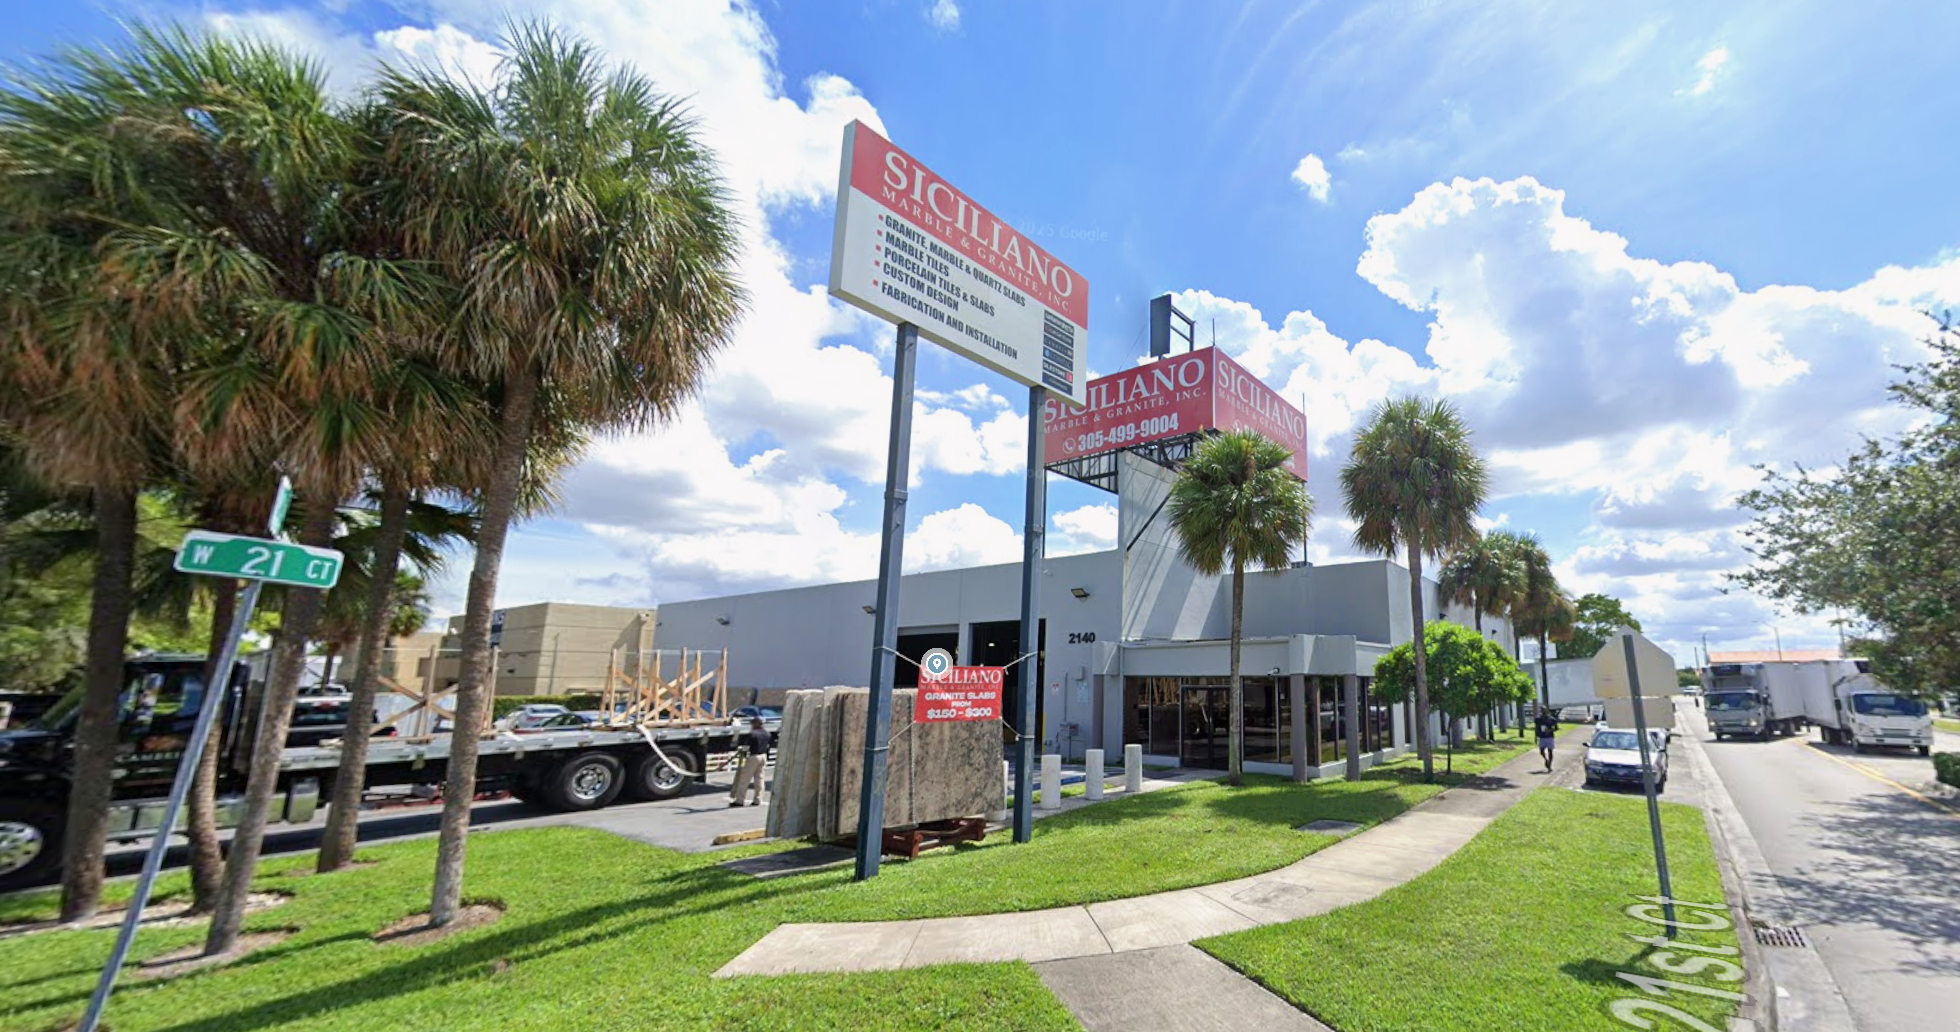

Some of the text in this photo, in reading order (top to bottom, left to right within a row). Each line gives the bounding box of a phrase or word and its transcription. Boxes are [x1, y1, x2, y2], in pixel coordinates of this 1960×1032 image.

[884, 151, 1072, 297] SICILIANO
[883, 186, 1072, 314] MARBLE & GRANITE, INC.
[885, 215, 1026, 307] GRANITE, MARBLE & QUARTZ SLABS
[886, 231, 949, 277] MARBLE TILES
[883, 262, 959, 311] CUSTOM DESIGN
[884, 247, 995, 317] PORCELAIN TILES & SLABS
[881, 282, 945, 323] FABRICATION
[946, 315, 964, 333] AND
[965, 325, 1018, 360] INSTALLATION
[1094, 411, 1100, 422] &
[1106, 396, 1169, 419] GRANITE,
[1176, 387, 1207, 401] INC.
[1218, 360, 1304, 440] SICILIANO
[1218, 388, 1250, 416] MARBLE
[1078, 412, 1179, 452] 305-499-9004
[193, 545, 333, 580] W 21 CT
[1068, 632, 1096, 644] 2140
[925, 692, 996, 701] GRANITE SLABS
[927, 708, 956, 719] $150
[965, 707, 992, 717] $300
